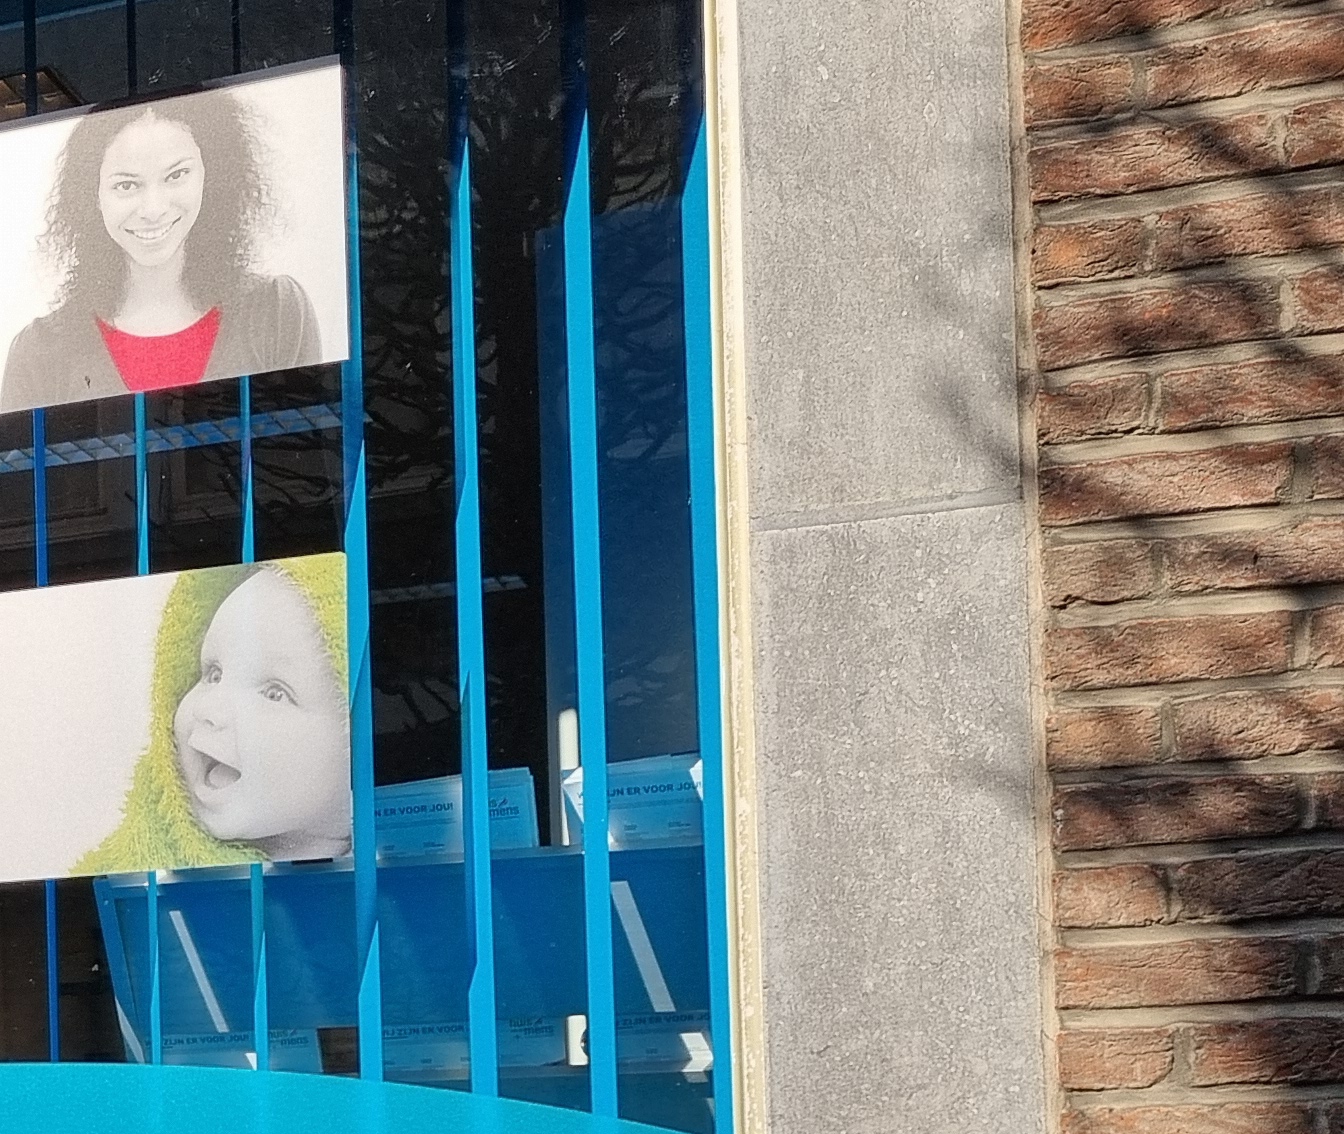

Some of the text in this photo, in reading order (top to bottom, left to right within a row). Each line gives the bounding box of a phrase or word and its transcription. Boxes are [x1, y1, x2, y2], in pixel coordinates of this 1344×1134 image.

[627, 787, 641, 796] ER
[643, 783, 675, 795] VOOR
[399, 804, 427, 815] VOOR
[201, 1035, 226, 1045] VOOR
